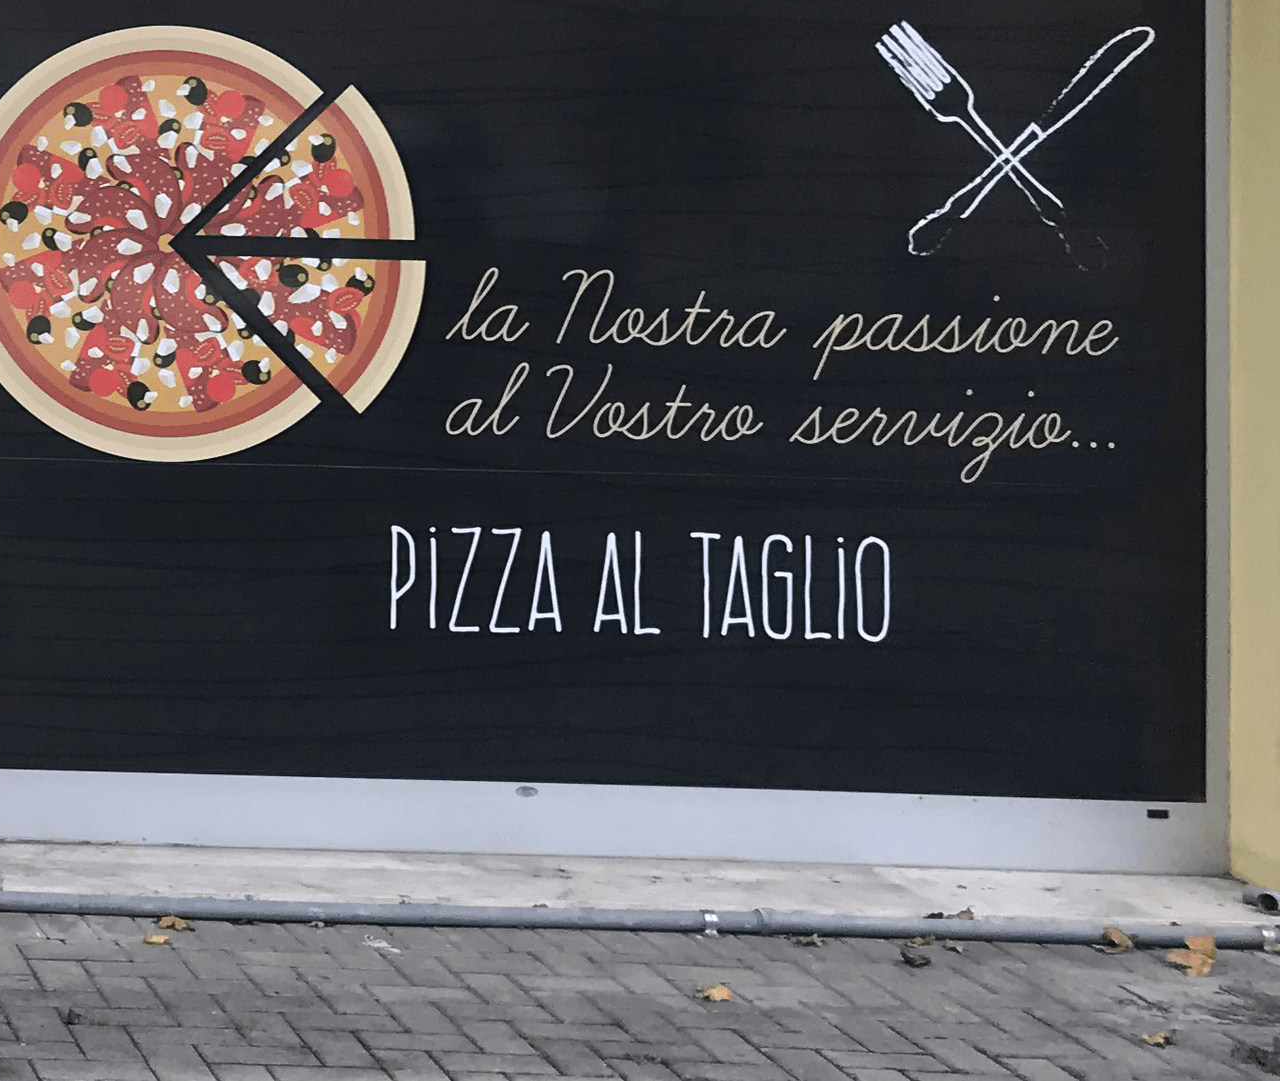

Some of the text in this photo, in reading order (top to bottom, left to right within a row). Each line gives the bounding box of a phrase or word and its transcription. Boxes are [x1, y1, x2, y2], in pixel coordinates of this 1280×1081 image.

[445, 266, 1120, 381] la Nostra passione
[445, 362, 1117, 484] al Vostro servizio...
[593, 531, 662, 636] AL
